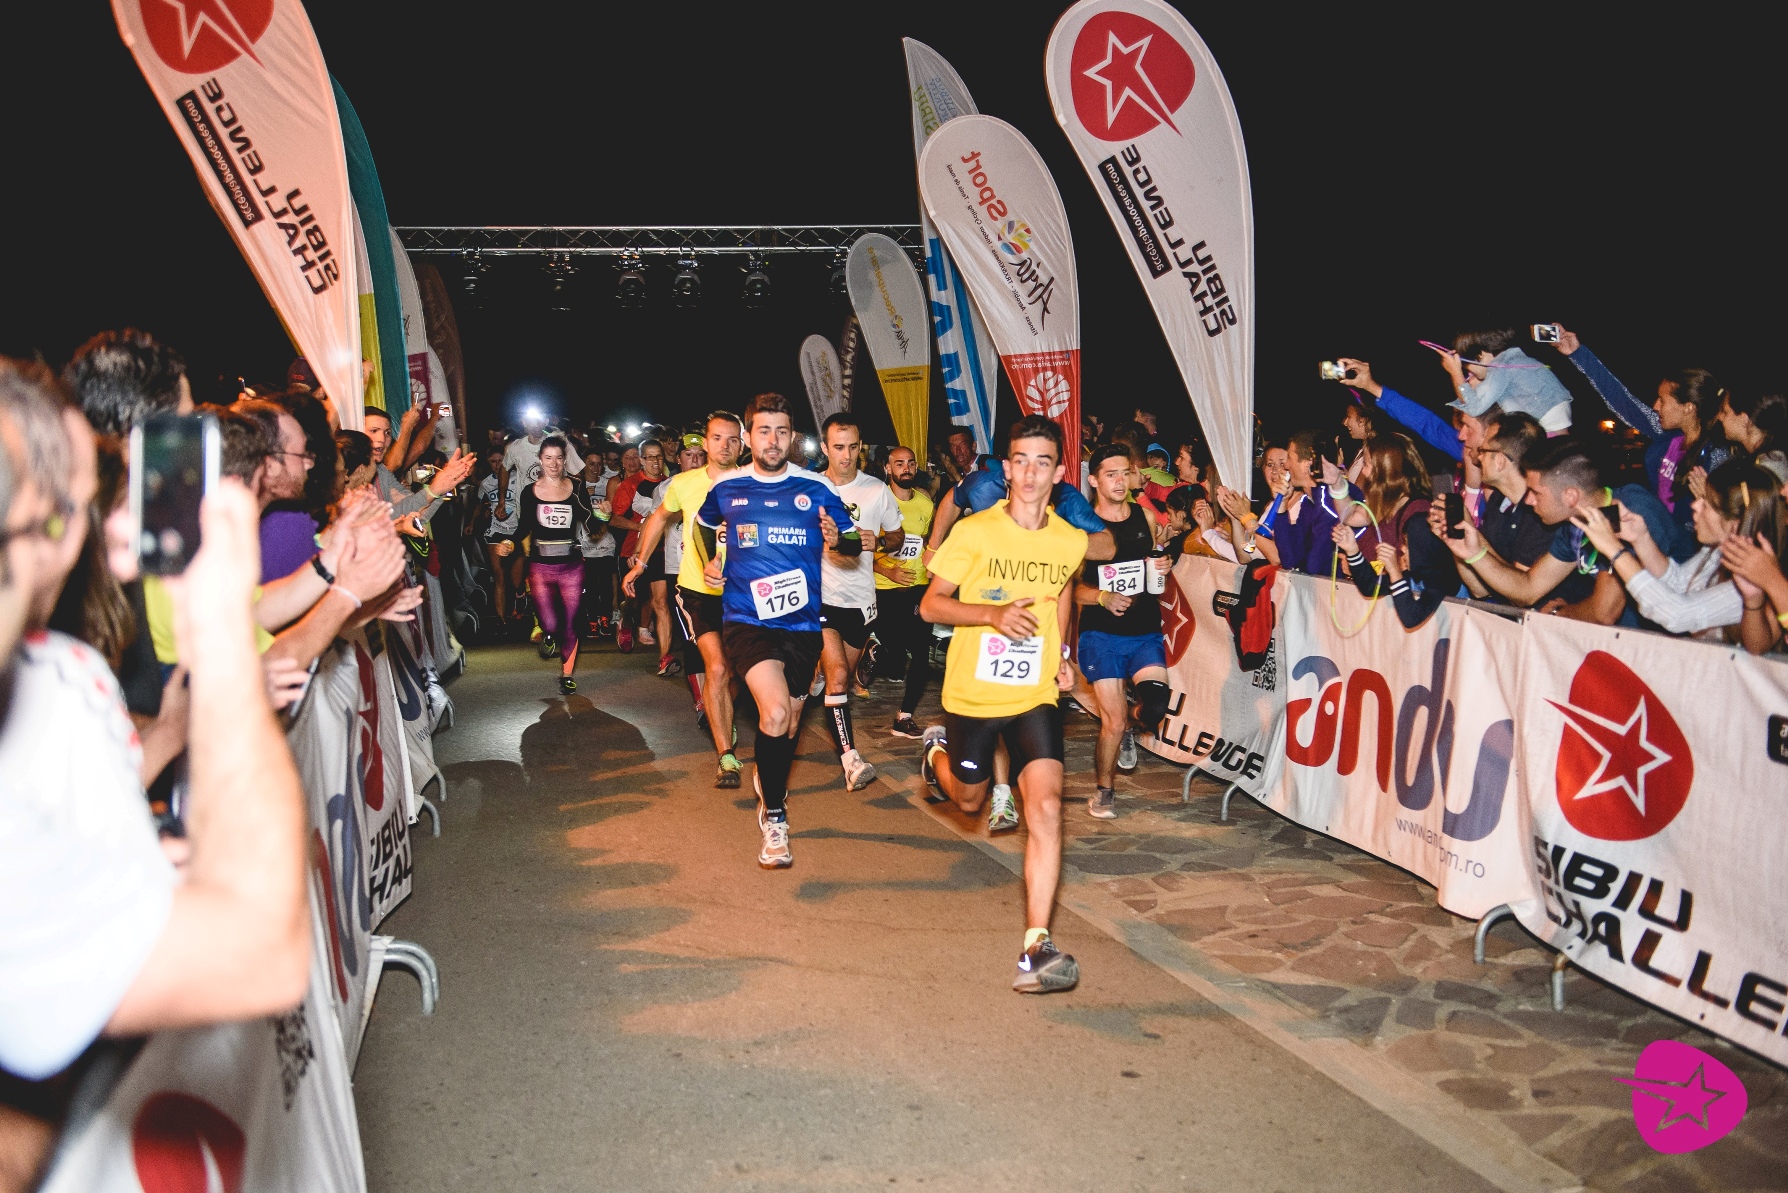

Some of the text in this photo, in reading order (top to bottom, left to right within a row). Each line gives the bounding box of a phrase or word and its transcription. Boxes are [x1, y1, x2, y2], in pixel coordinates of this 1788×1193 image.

[731, 498, 749, 507] JAKO
[545, 515, 567, 526] 192
[988, 557, 1069, 585] INVICTUS
[1107, 577, 1137, 592] 184
[765, 590, 800, 613] 176
[990, 659, 1030, 679] 129
[1155, 717, 1265, 781] LLENGE
[1534, 835, 1693, 933] SIBIU
[1540, 879, 1788, 1036] CHALLE
